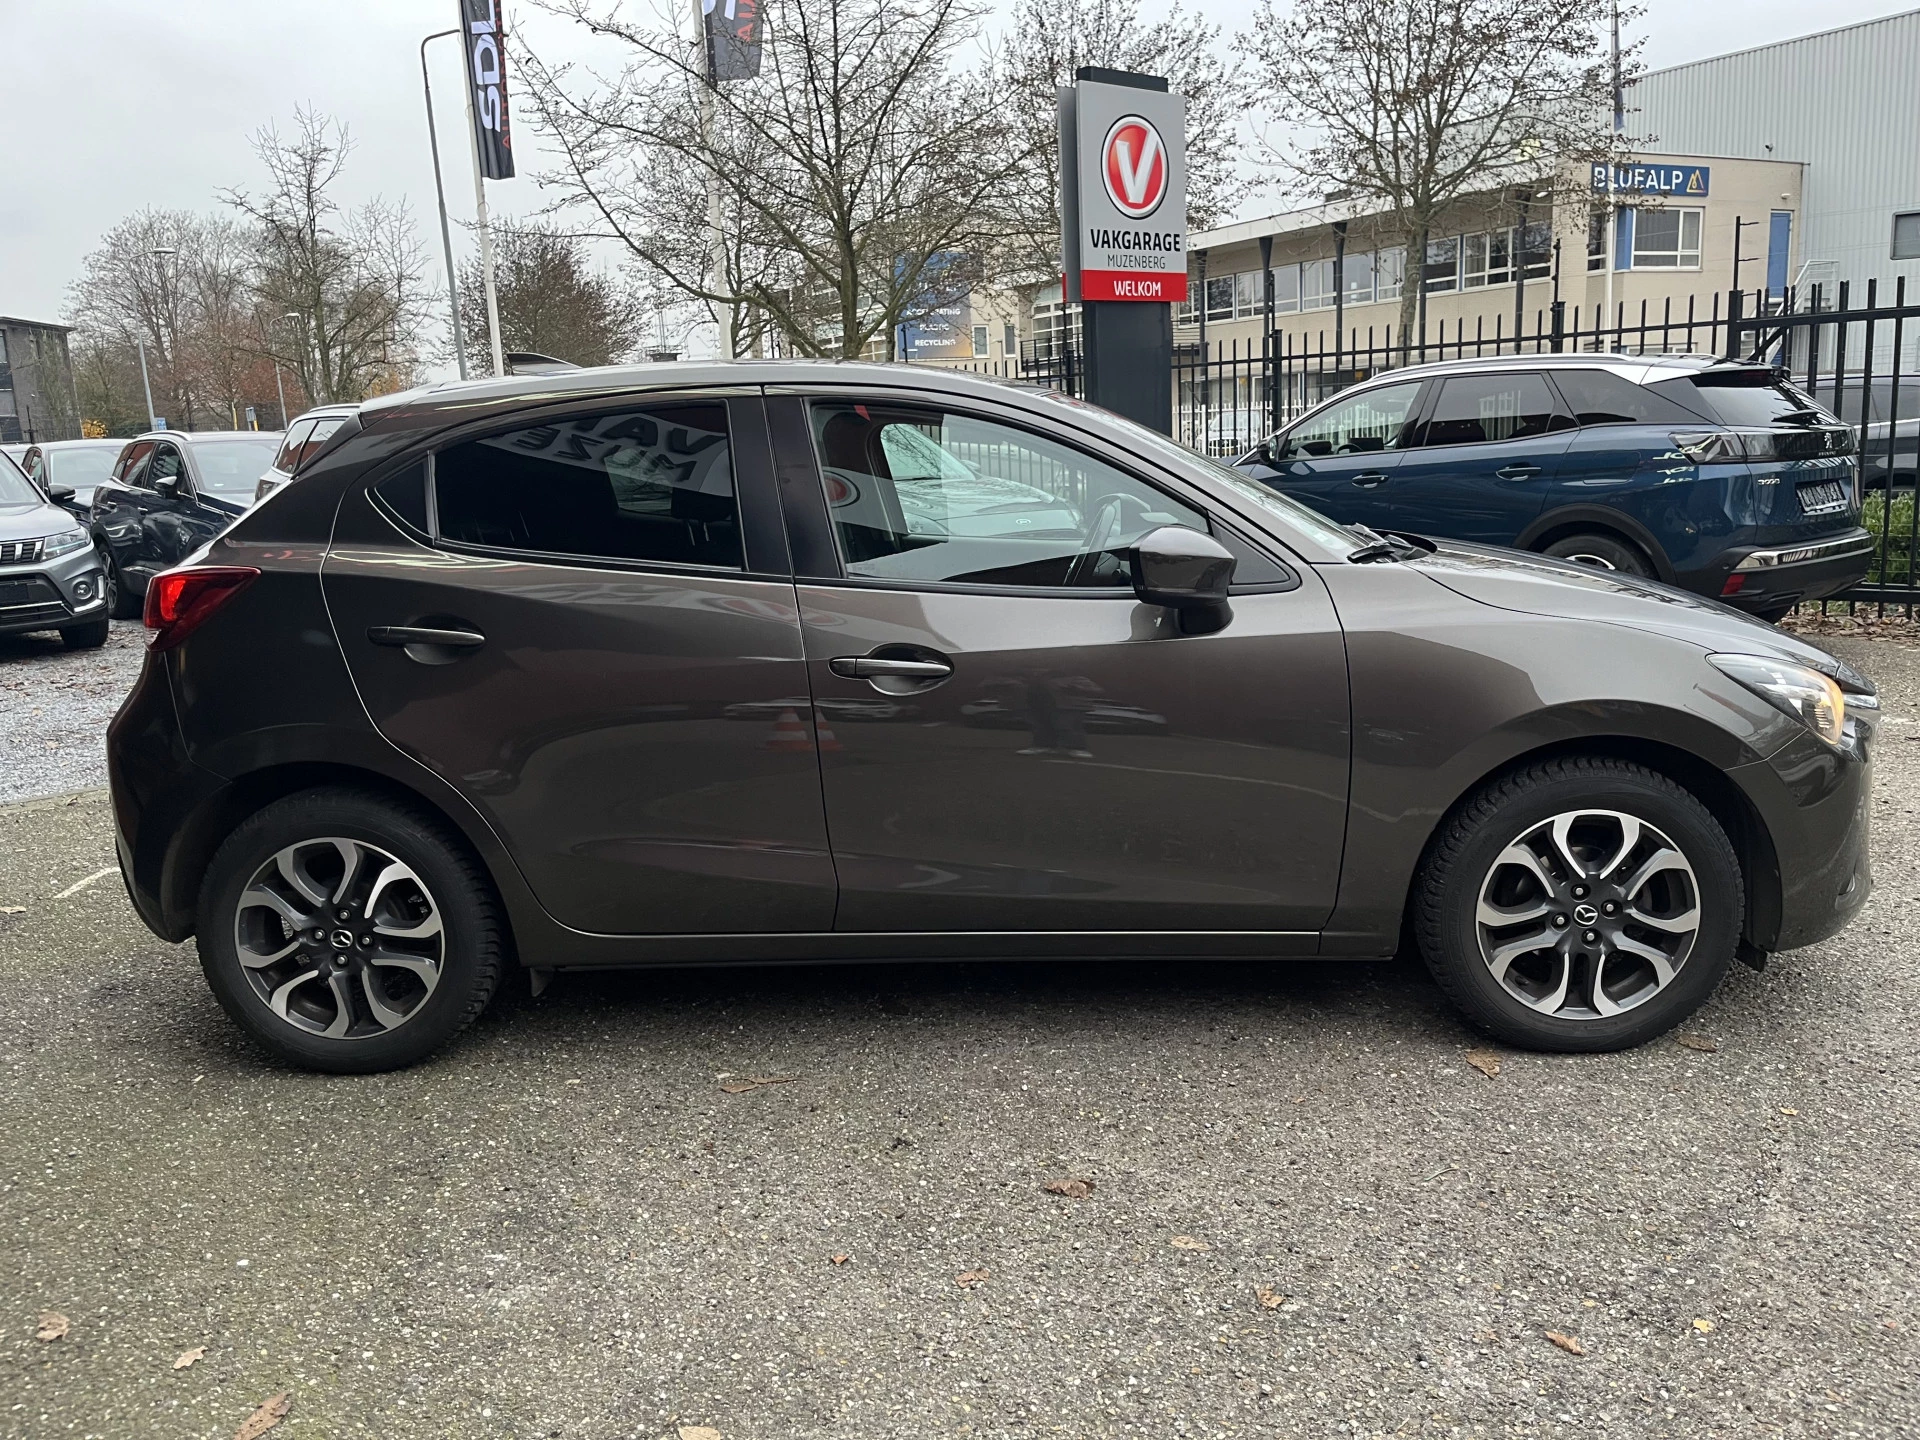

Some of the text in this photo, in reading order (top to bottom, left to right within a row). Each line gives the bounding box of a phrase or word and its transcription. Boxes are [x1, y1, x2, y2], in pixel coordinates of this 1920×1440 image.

[471, 0, 501, 132] SDL
[1115, 128, 1161, 204] V
[1090, 228, 1181, 252] VAKGARAGE
[1107, 254, 1167, 270] MUZENBERG
[1113, 280, 1162, 297] WELKOM
[914, 339, 956, 347] RECYCLING
